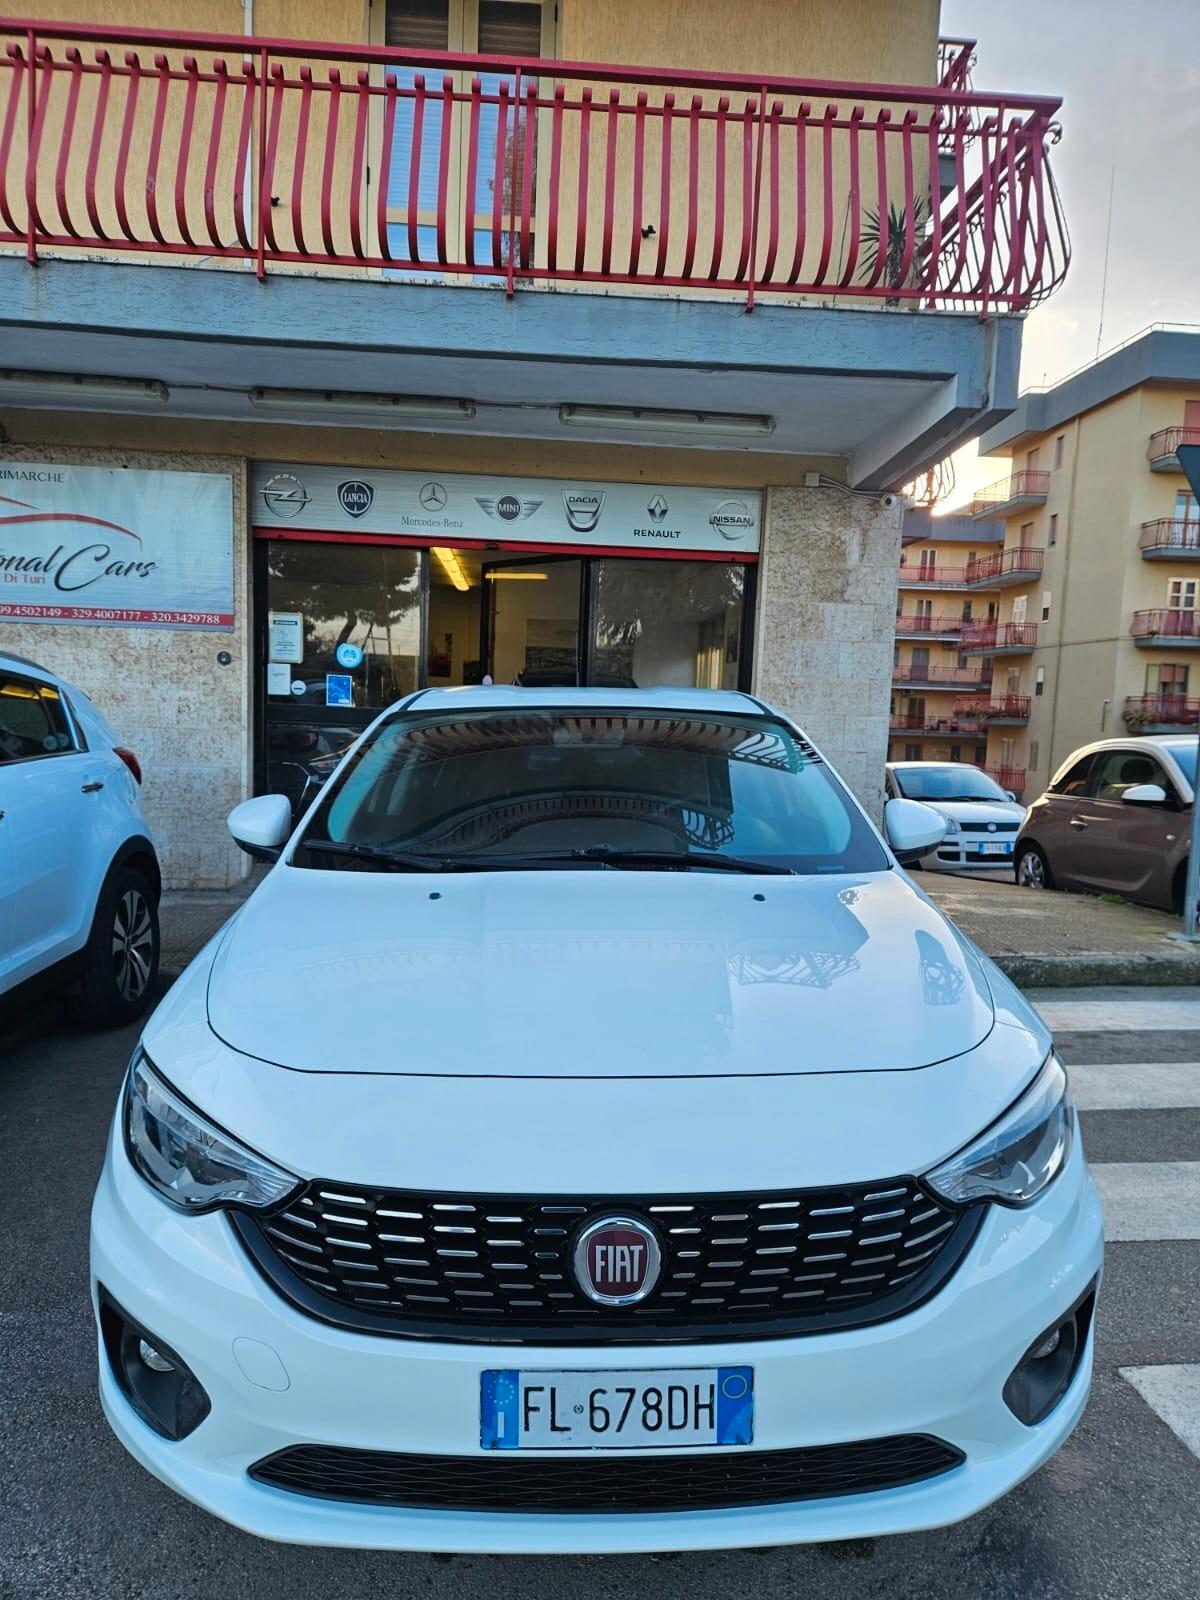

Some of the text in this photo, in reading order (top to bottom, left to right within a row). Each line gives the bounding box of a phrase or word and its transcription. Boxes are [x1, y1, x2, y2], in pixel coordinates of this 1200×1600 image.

[344, 492, 368, 503] LANCIA
[568, 496, 598, 504] DACIA
[499, 503, 519, 513] MINI
[401, 516, 464, 528] Mercedes-Benz
[713, 515, 751, 524] NISSAN
[633, 529, 681, 539] RENAULT
[54, 544, 158, 592] Cars
[4, 573, 45, 584] Di Turi
[72, 608, 141, 621] 329.4007177
[151, 612, 220, 624] 320.3429788
[595, 1245, 643, 1282] FIAT
[523, 1384, 715, 1432] FL 678DH
